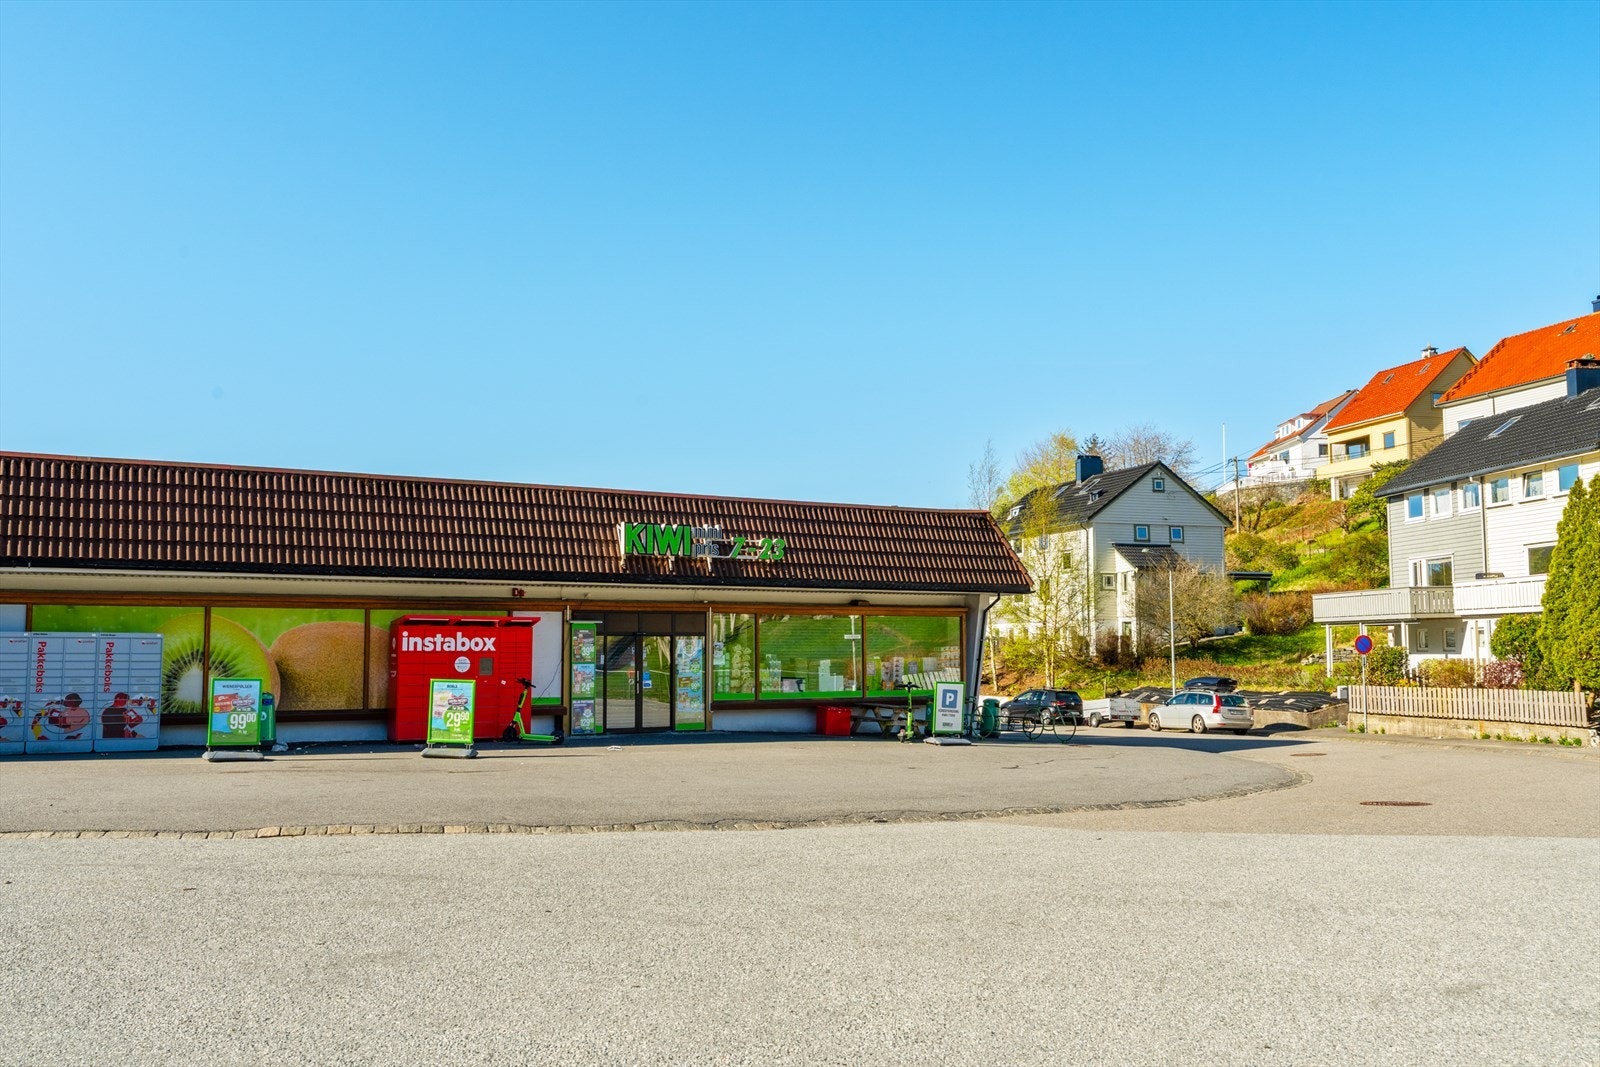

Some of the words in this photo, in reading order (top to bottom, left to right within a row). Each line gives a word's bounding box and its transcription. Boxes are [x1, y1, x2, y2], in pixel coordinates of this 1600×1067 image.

[624, 522, 692, 557] KIWI
[694, 540, 720, 557] pris
[402, 631, 496, 651] instabox
[36, 641, 46, 693] Pakkeboks
[104, 641, 114, 693] Pakkeboks
[946, 693, 954, 705] P
